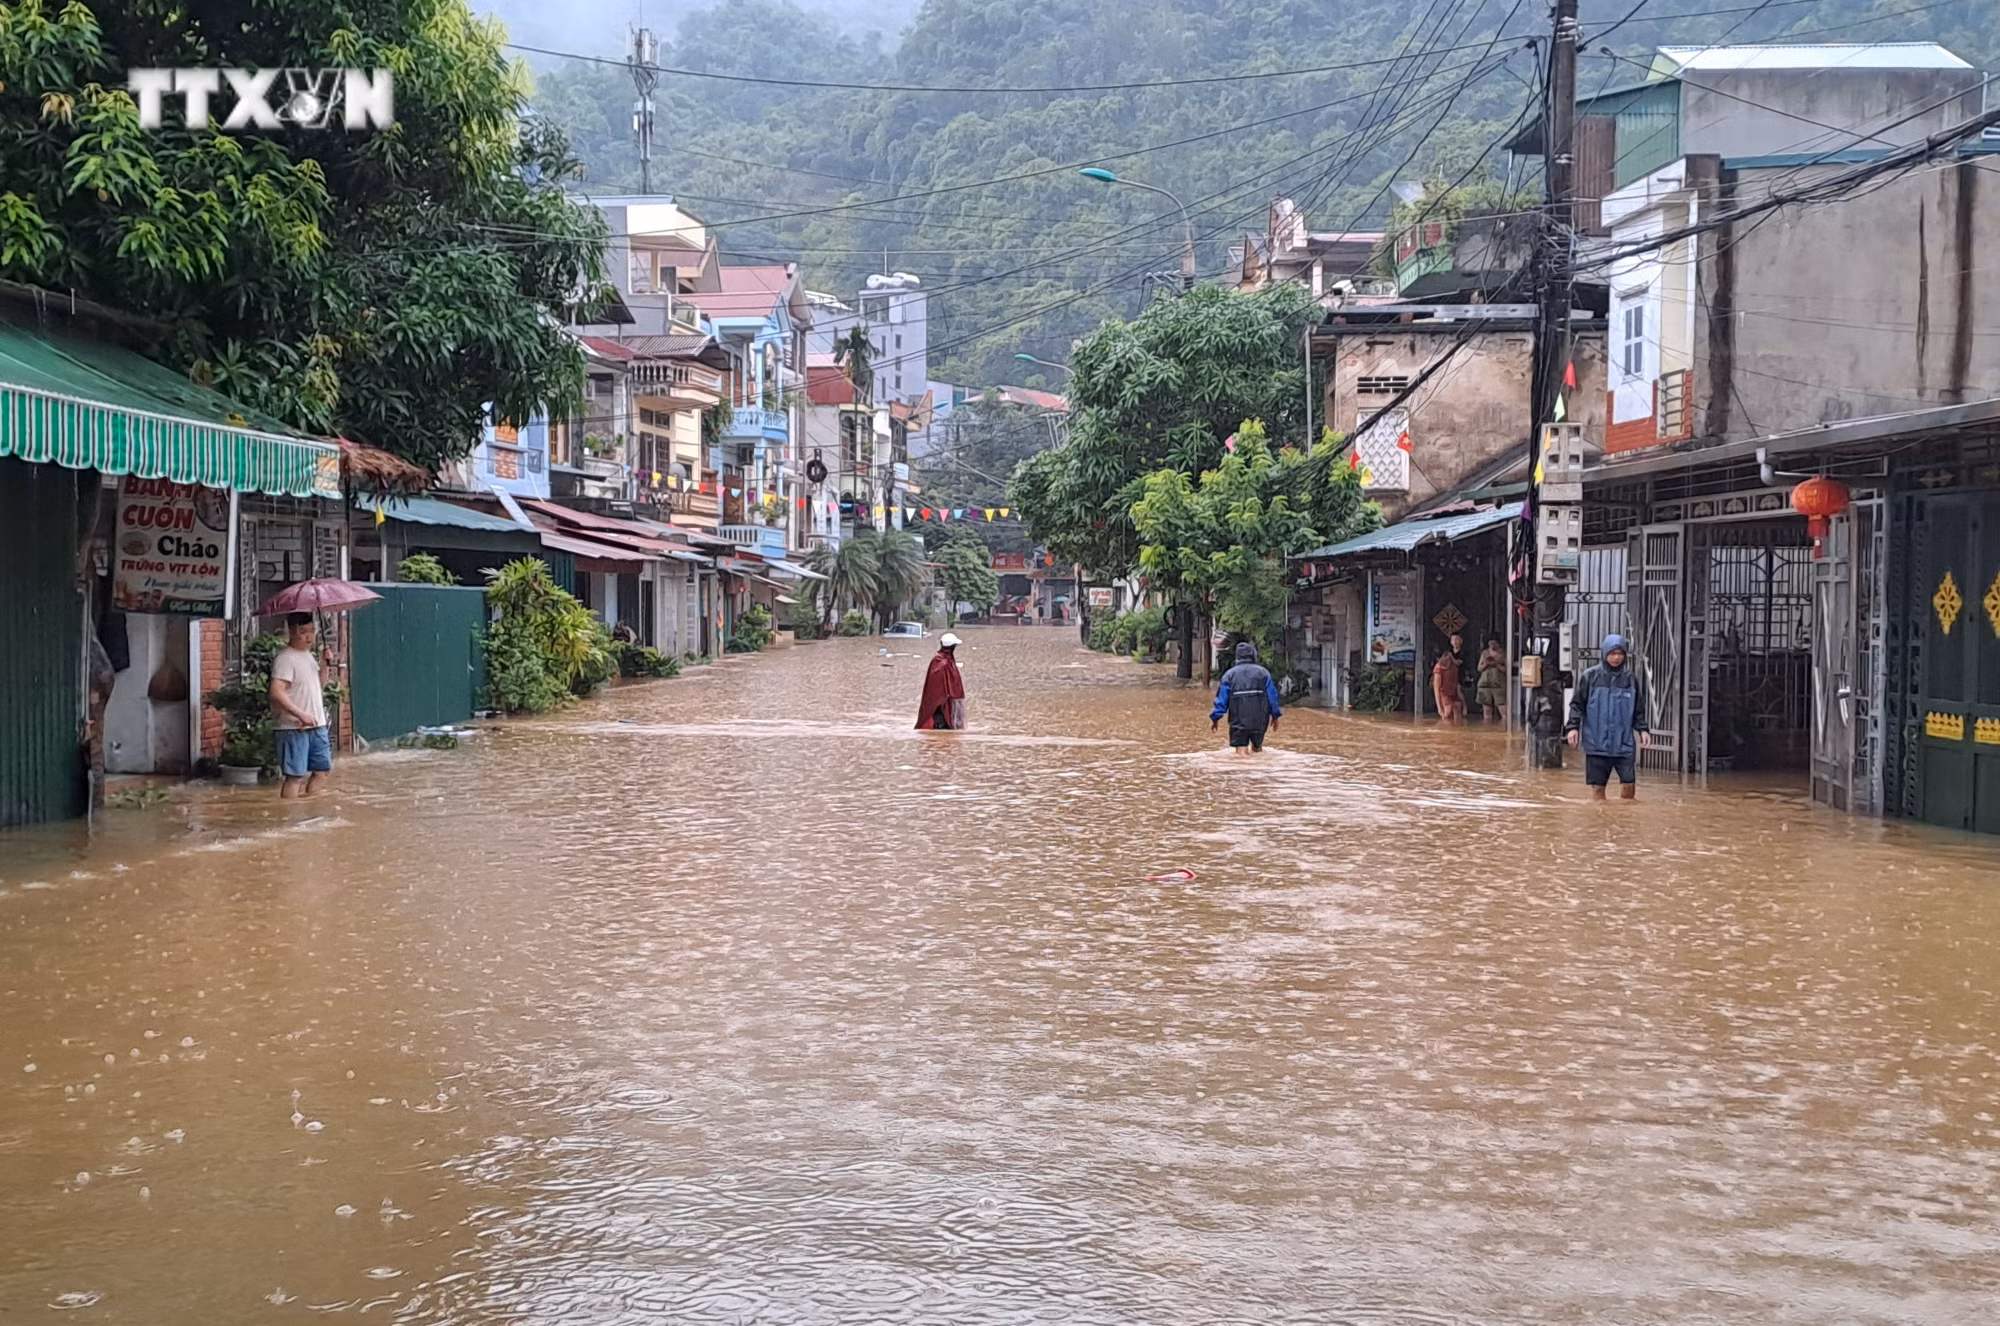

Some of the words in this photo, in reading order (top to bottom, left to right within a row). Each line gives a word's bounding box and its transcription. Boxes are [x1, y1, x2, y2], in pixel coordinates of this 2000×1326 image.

[122, 501, 194, 530] CUỐN
[157, 535, 219, 559] Cháo
[190, 562, 221, 577] LỘN
